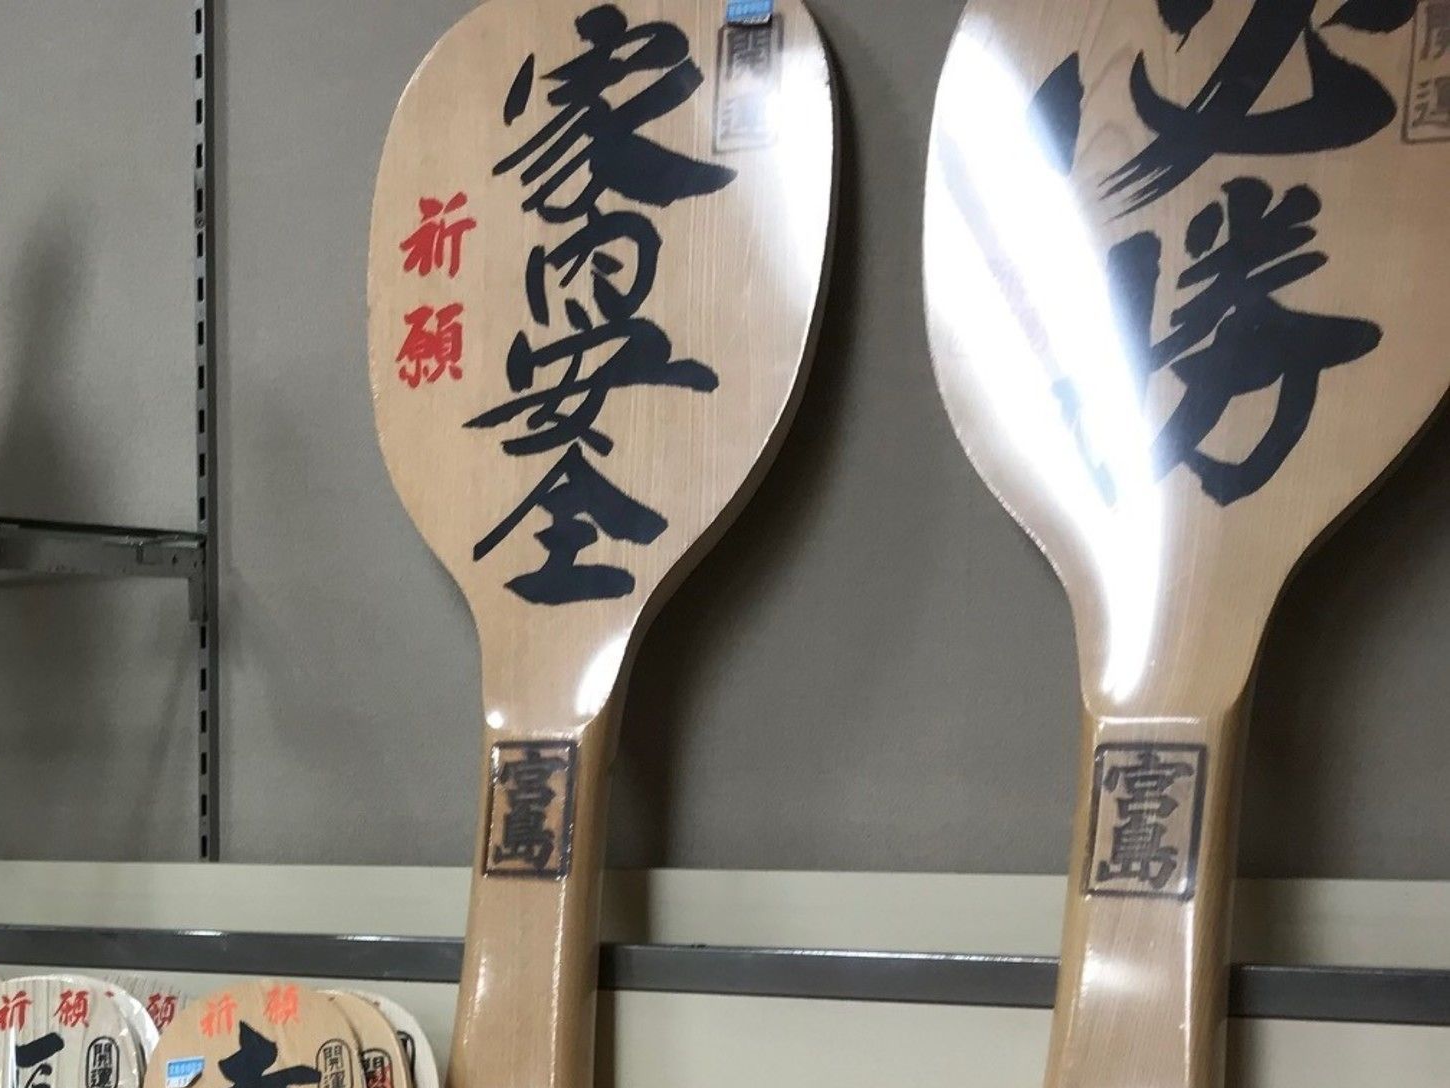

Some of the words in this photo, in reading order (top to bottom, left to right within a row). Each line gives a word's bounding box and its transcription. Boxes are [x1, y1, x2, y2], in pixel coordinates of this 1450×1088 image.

[396, 190, 477, 389] 祈願
[462, 3, 738, 605] 家内安全
[1025, 0, 1398, 508] 必勝
[493, 748, 569, 872] 宮島
[1096, 749, 1195, 891] 宮島
[200, 983, 300, 1037] 祈願
